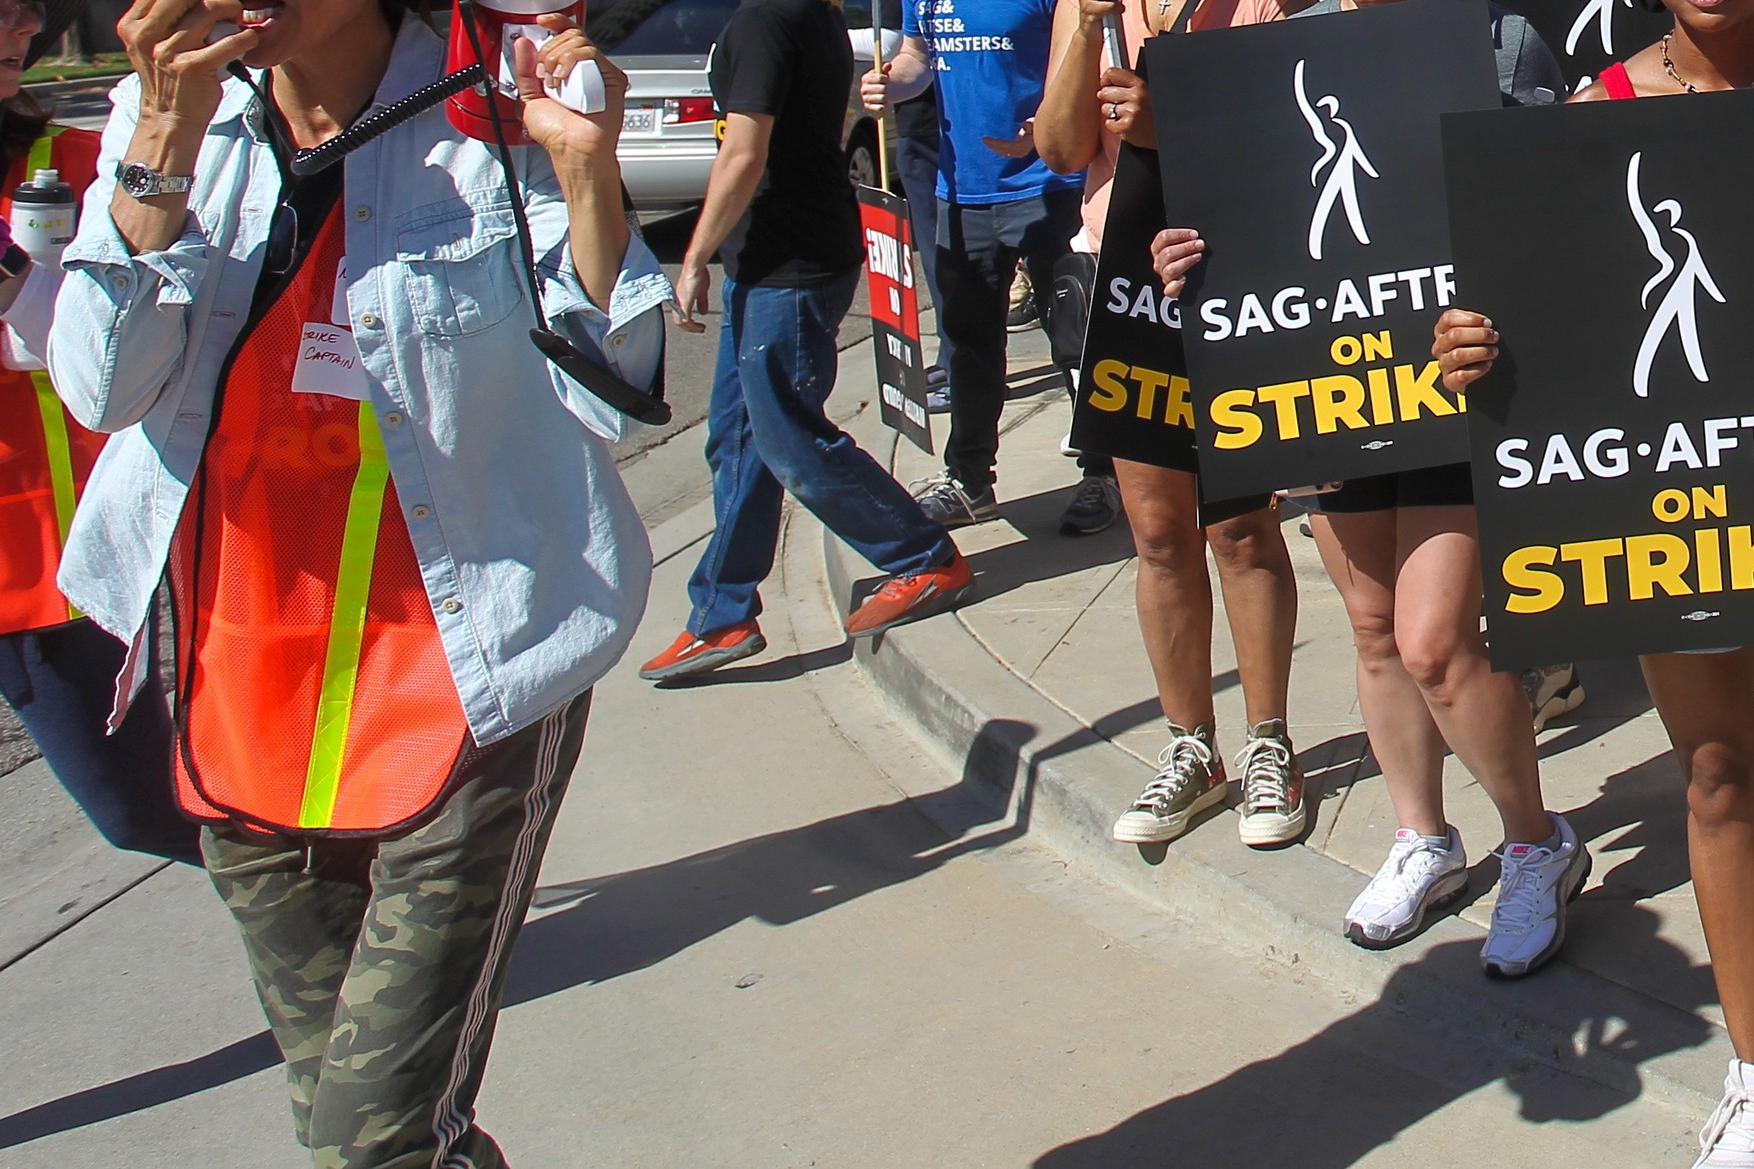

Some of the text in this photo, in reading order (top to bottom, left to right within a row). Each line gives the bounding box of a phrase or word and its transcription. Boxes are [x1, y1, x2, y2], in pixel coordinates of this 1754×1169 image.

[918, 0, 955, 16] SAG&
[923, 36, 1015, 52] EAMSTERS&
[866, 227, 913, 290] STRIKE!
[303, 331, 341, 344] RIKE
[1330, 330, 1394, 366] ON
[304, 346, 356, 370] CAPTAIN
[1210, 359, 1467, 450] STRIK
[1651, 485, 1727, 523] ON
